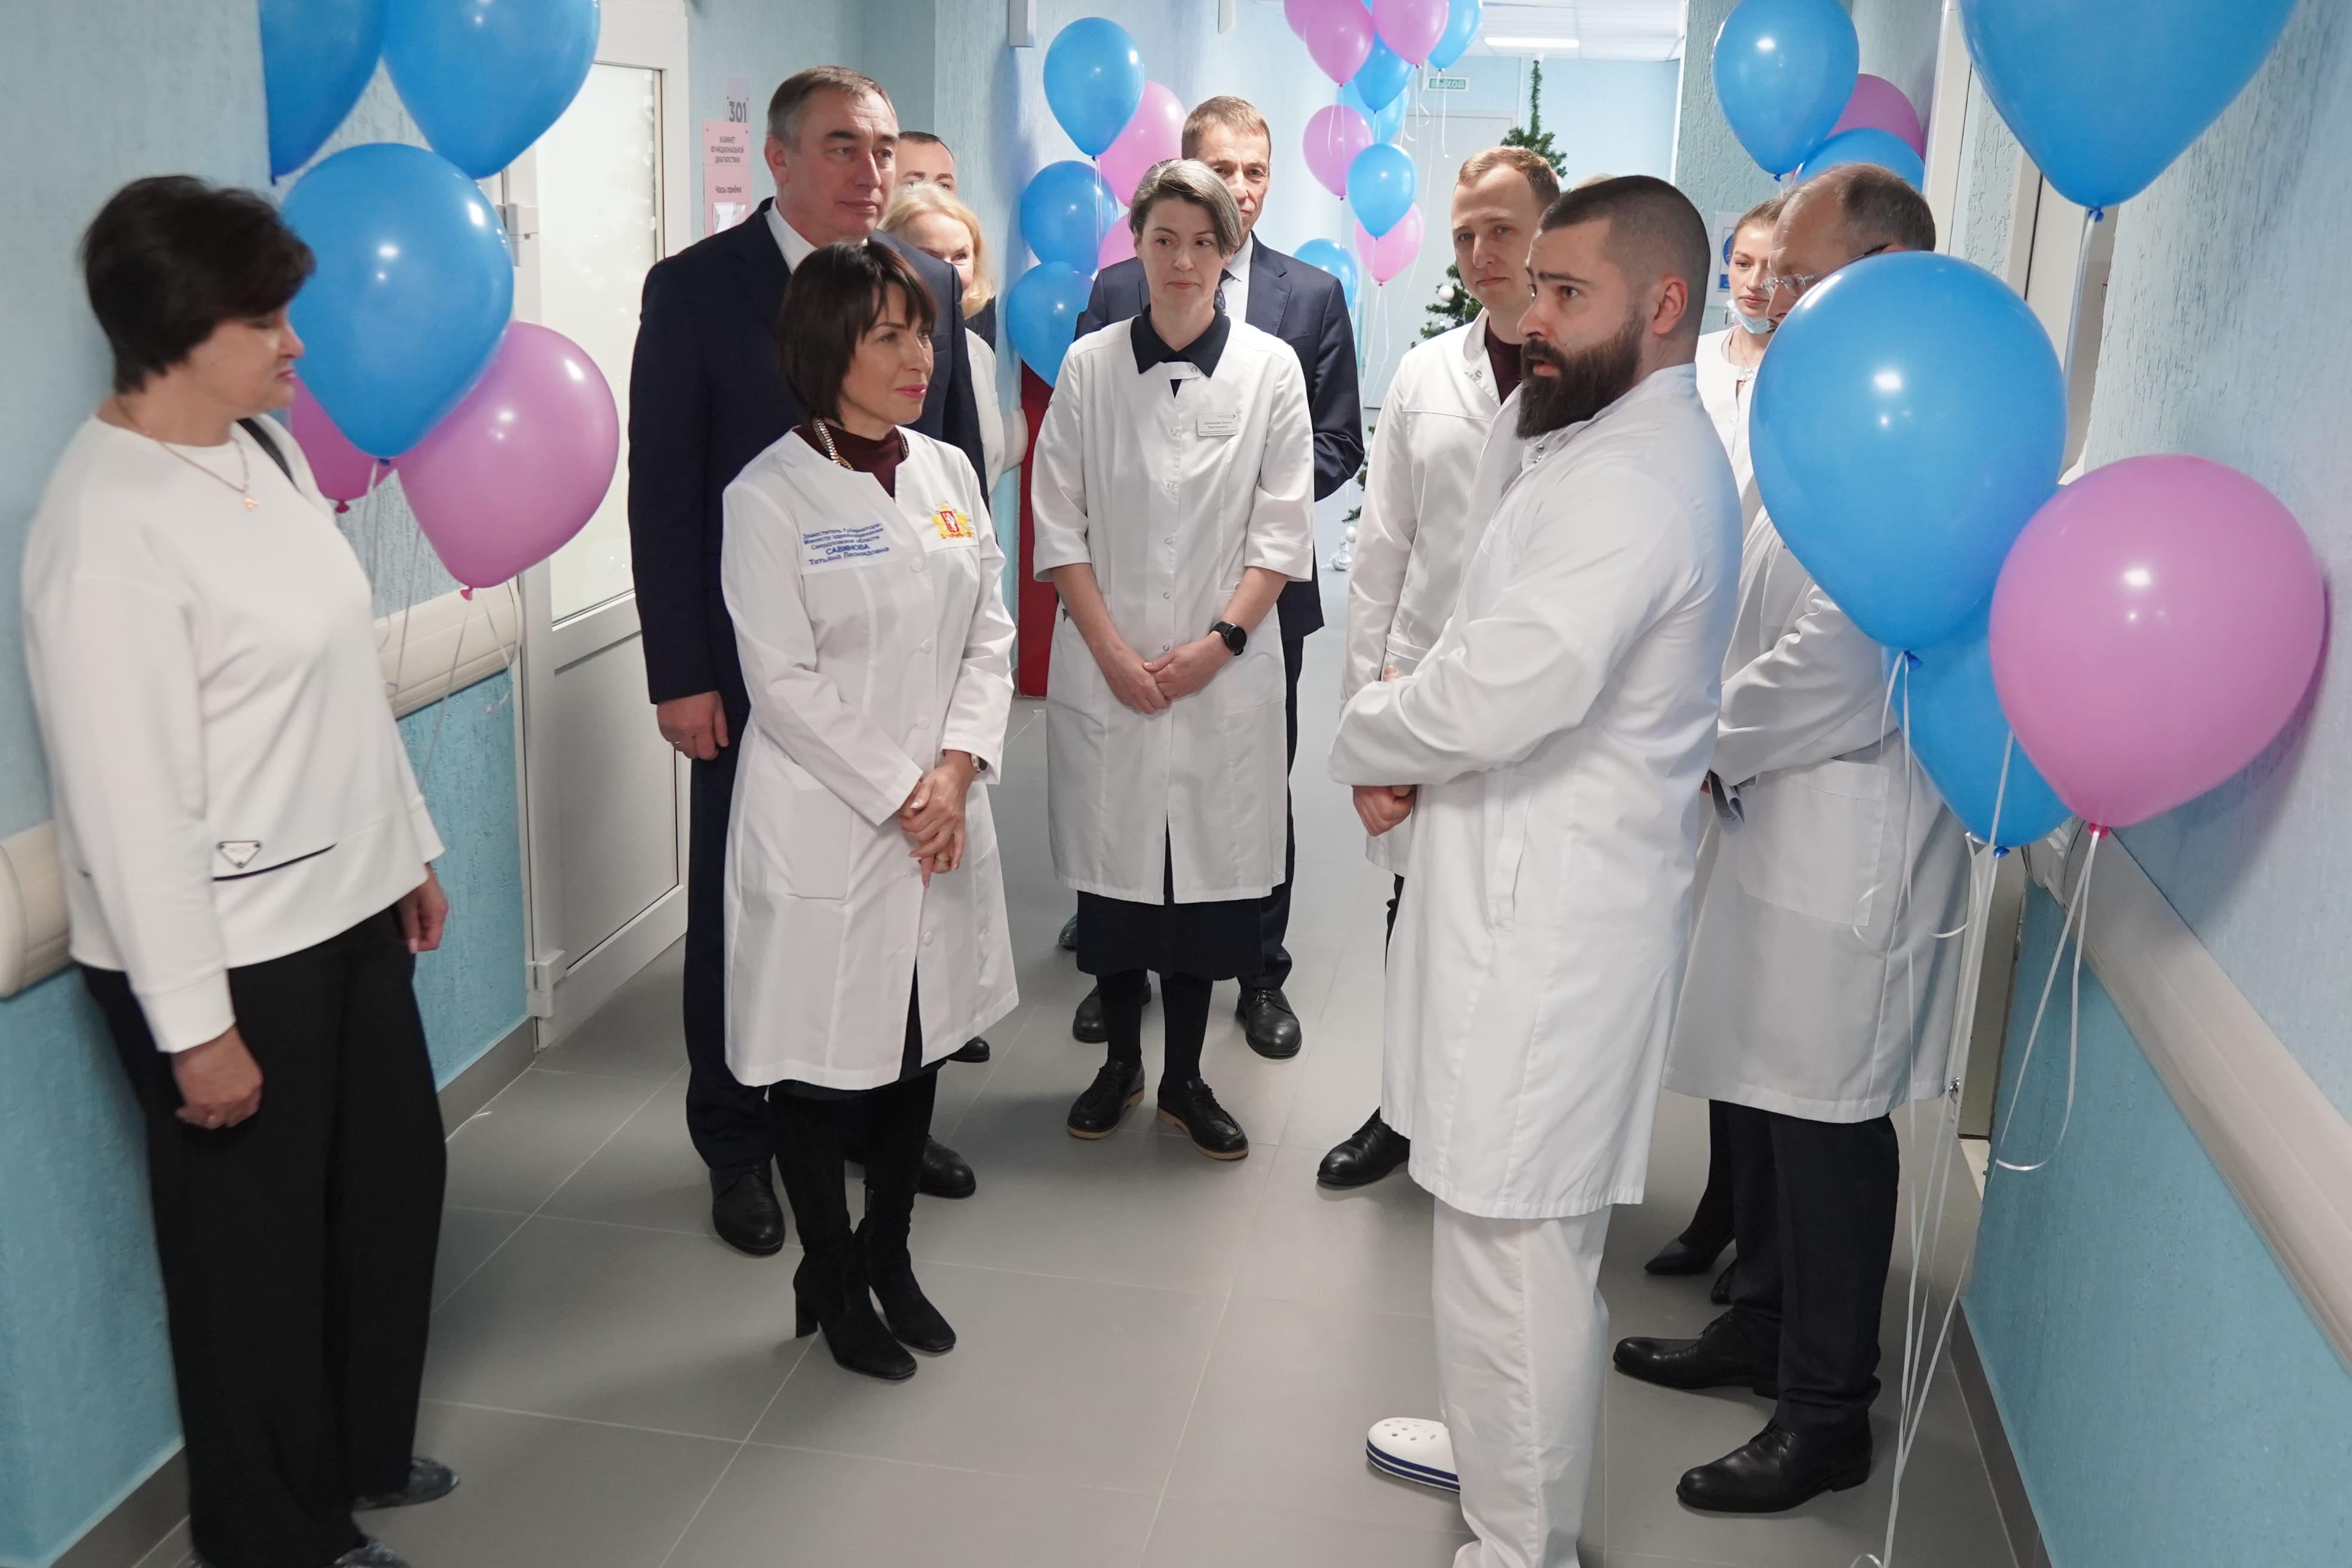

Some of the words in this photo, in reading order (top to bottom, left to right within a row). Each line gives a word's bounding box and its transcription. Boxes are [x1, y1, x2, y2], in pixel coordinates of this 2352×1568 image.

[1431, 79, 1465, 88] ВЫХОД
[729, 102, 747, 123] 301
[803, 529, 842, 539] Заместитель
[804, 535, 832, 545] Министр
[810, 539, 855, 550] Свердловской
[825, 544, 870, 555] САВИНОВА
[808, 555, 841, 565] Татьяна
[843, 547, 889, 558] Леонидовна
